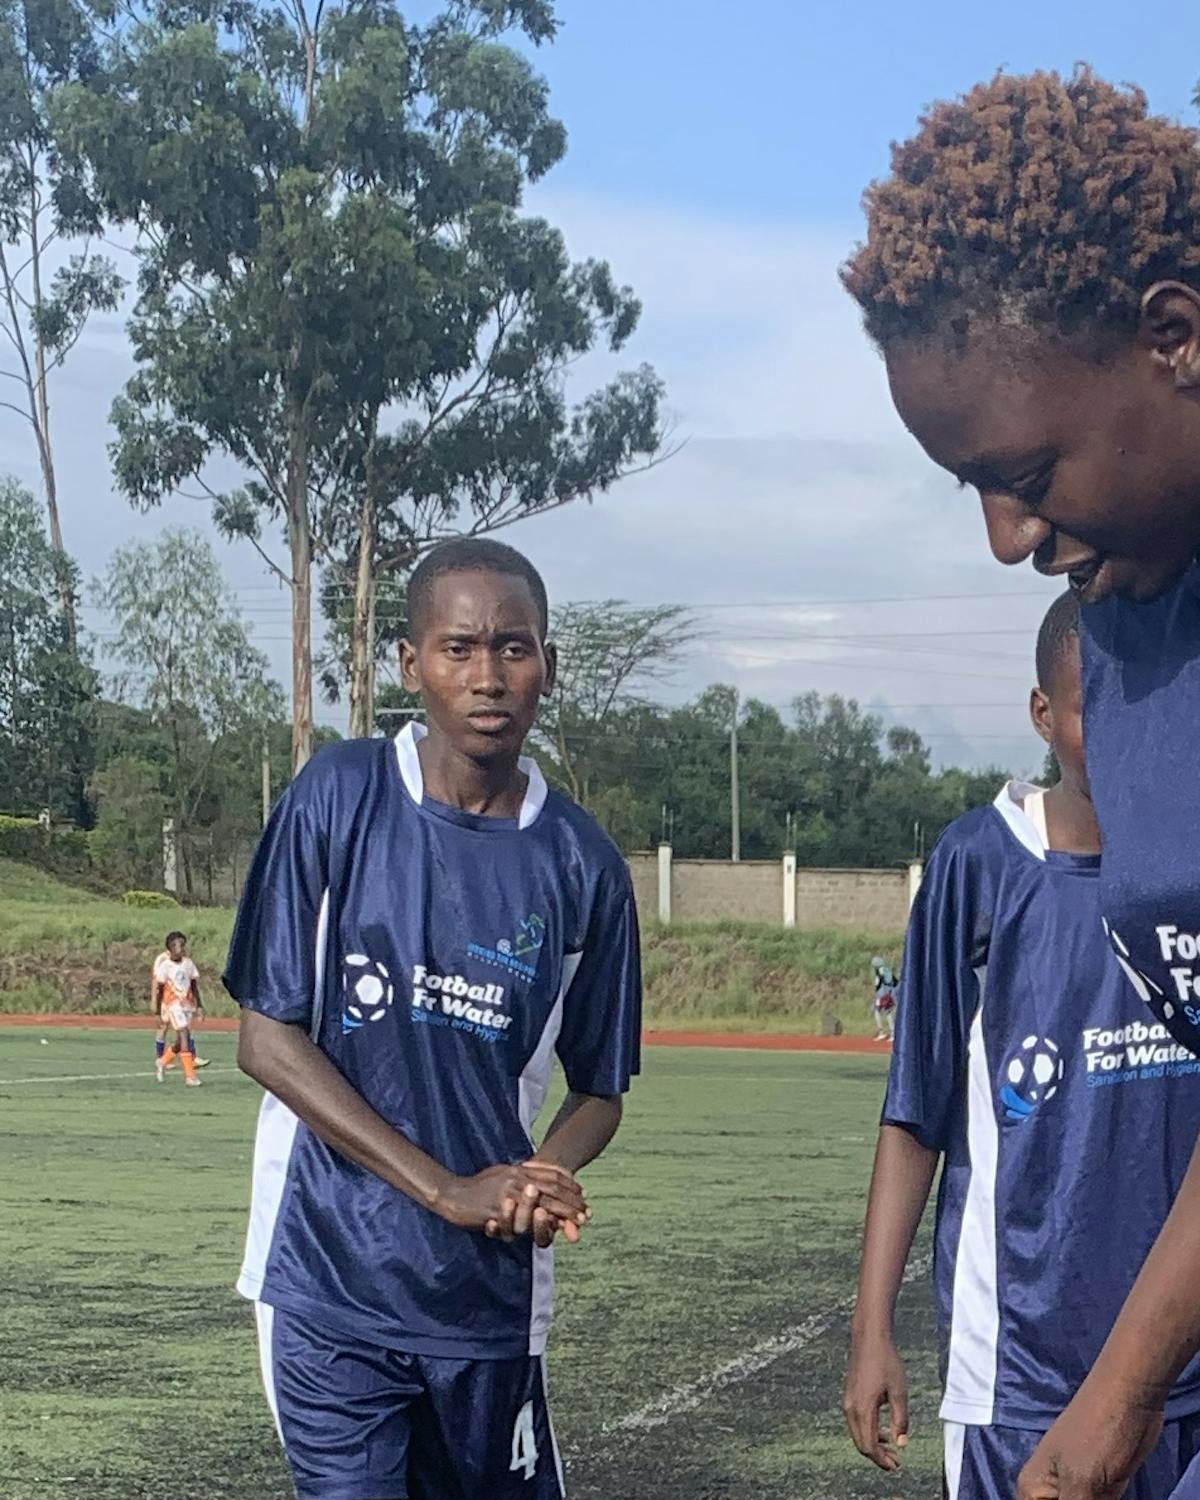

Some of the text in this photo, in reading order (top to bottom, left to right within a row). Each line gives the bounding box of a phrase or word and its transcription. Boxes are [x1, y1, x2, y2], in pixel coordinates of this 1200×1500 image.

[413, 965, 504, 1005] Fotball
[412, 988, 437, 1011] Fr
[441, 995, 513, 1029] Water
[1083, 1021, 1171, 1049] Footba
[1086, 1044, 1197, 1072] For Wate
[509, 1399, 540, 1480] 4
